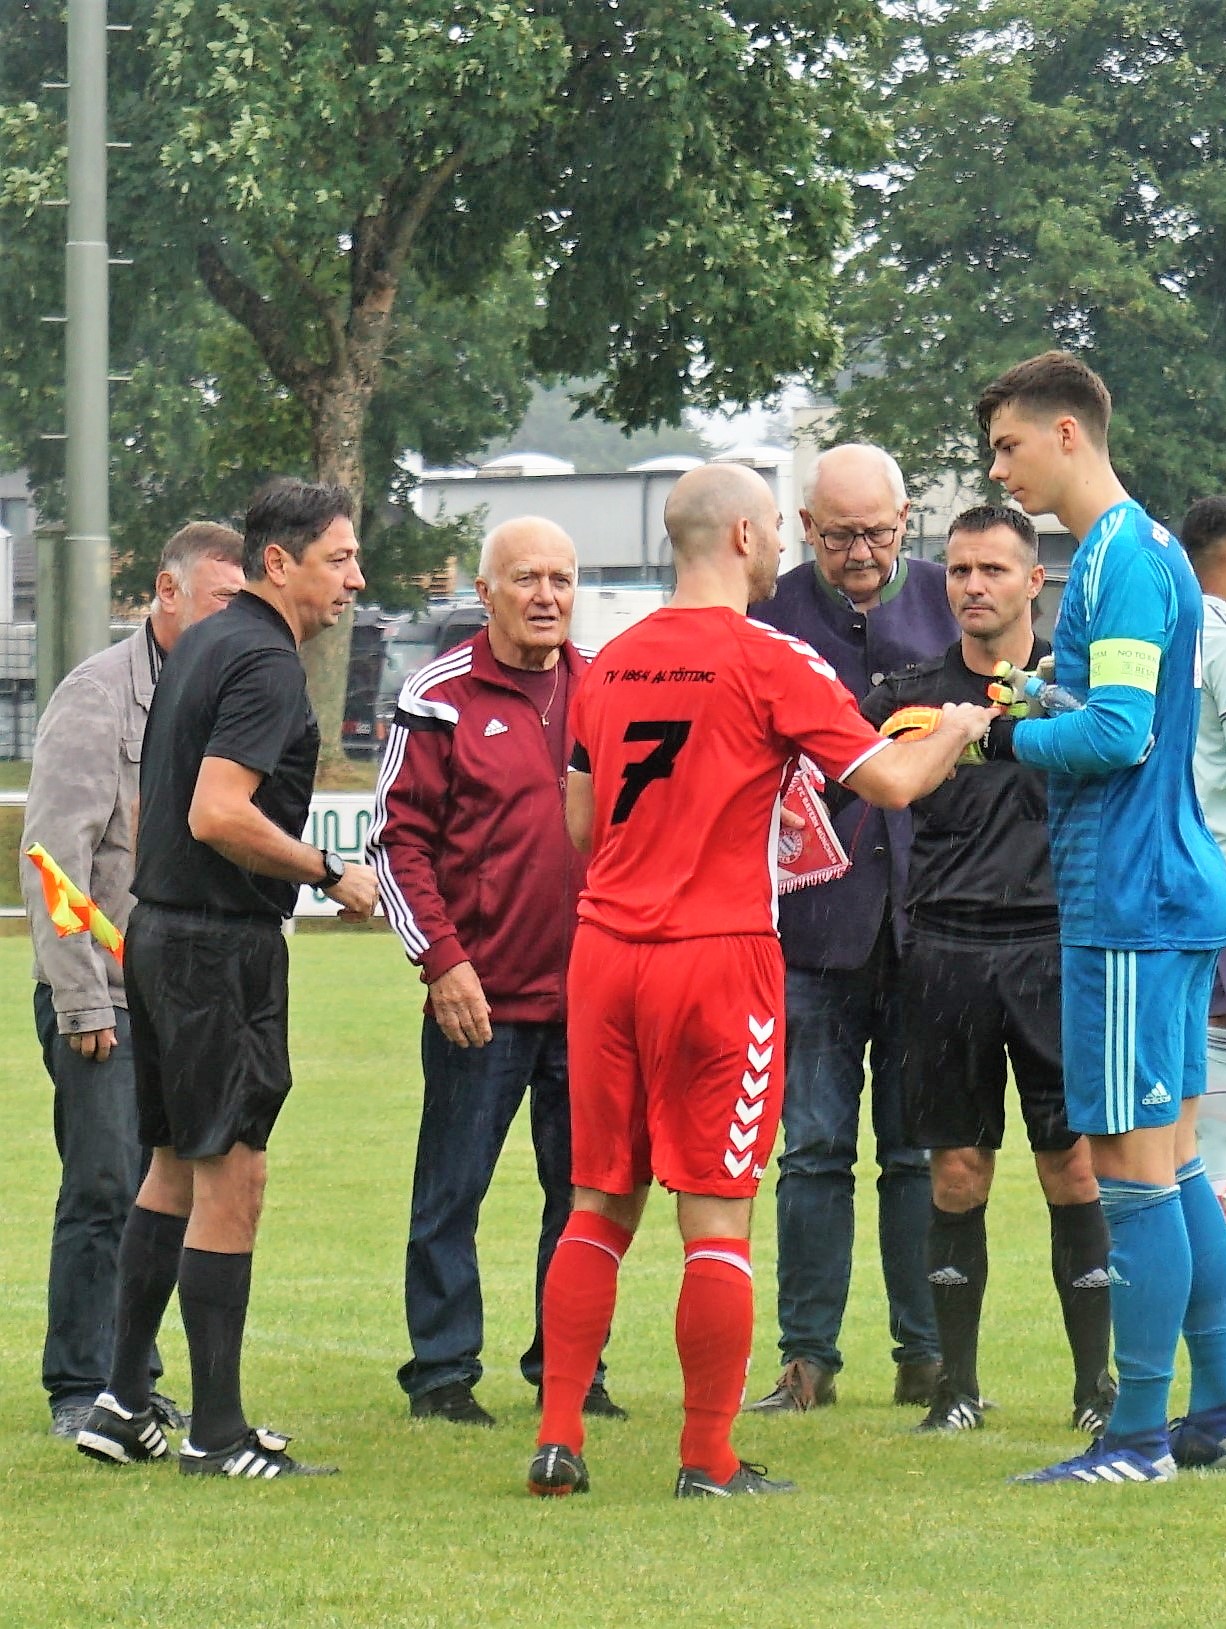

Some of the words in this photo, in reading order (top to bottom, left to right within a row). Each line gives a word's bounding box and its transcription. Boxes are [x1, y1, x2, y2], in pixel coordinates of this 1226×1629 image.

[603, 669, 619, 686] TV
[651, 666, 717, 685] ALTÖTTING
[610, 720, 693, 826] 7
[801, 794, 819, 829] BAYERN
